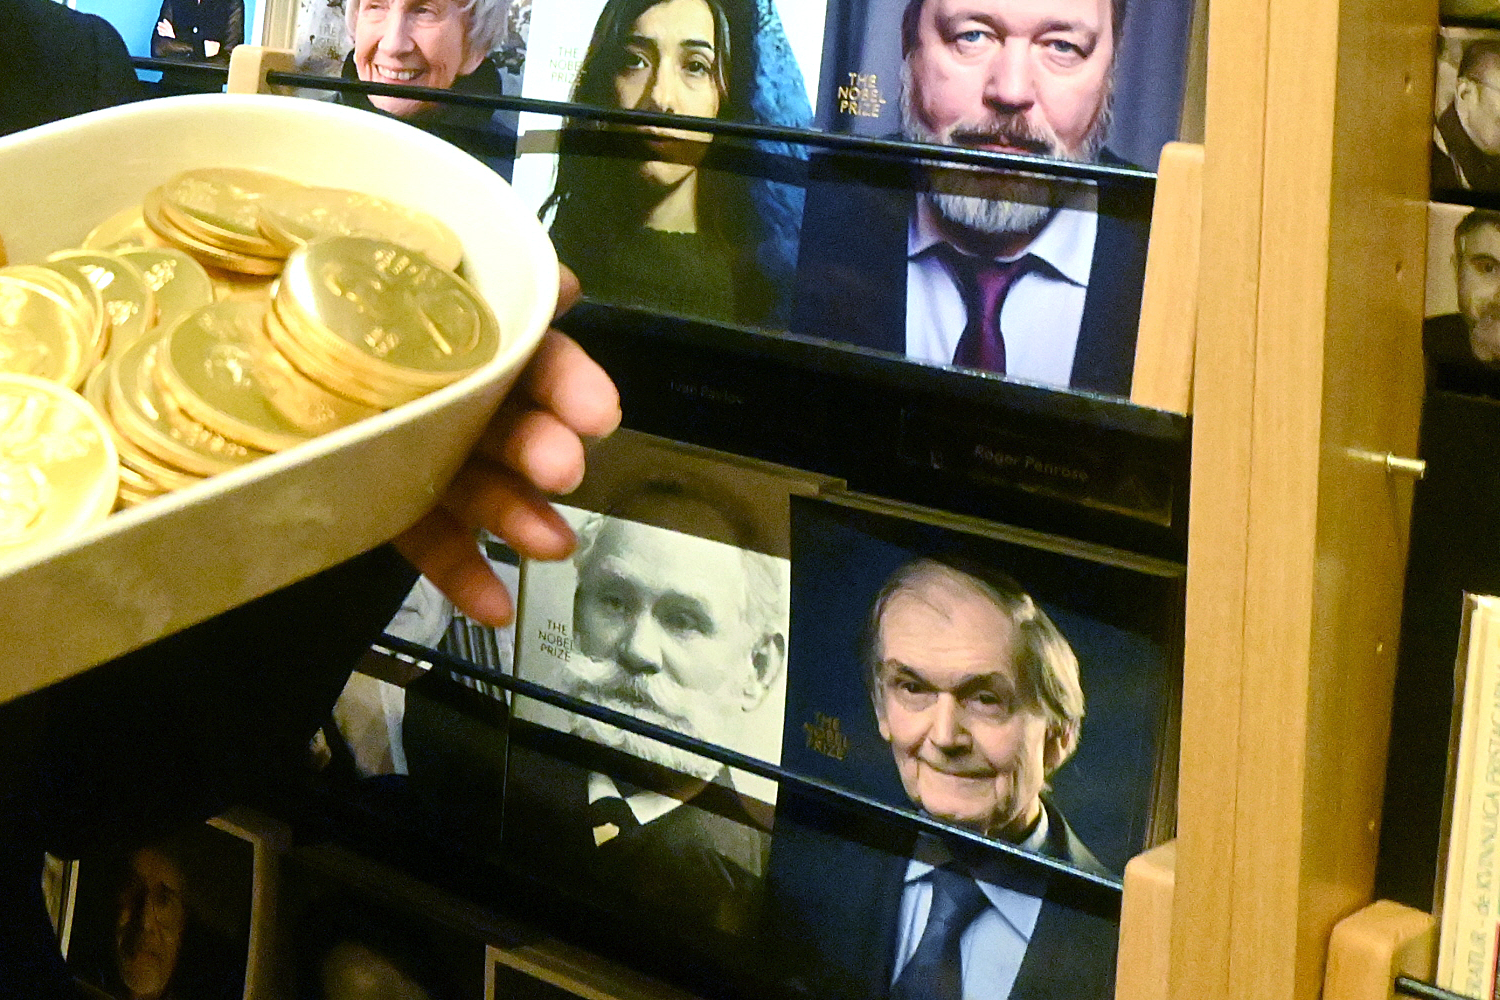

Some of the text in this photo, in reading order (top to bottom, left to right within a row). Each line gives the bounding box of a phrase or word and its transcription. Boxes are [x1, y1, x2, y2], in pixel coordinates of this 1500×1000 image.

[558, 46, 578, 59] THE
[848, 72, 877, 89] THE
[838, 86, 887, 104] NOBEL
[840, 100, 880, 118] PRIZE
[974, 443, 1090, 483] Roger Penrose
[548, 619, 568, 637] THE
[538, 630, 574, 650] NOBEL
[540, 643, 571, 663] PRIZE
